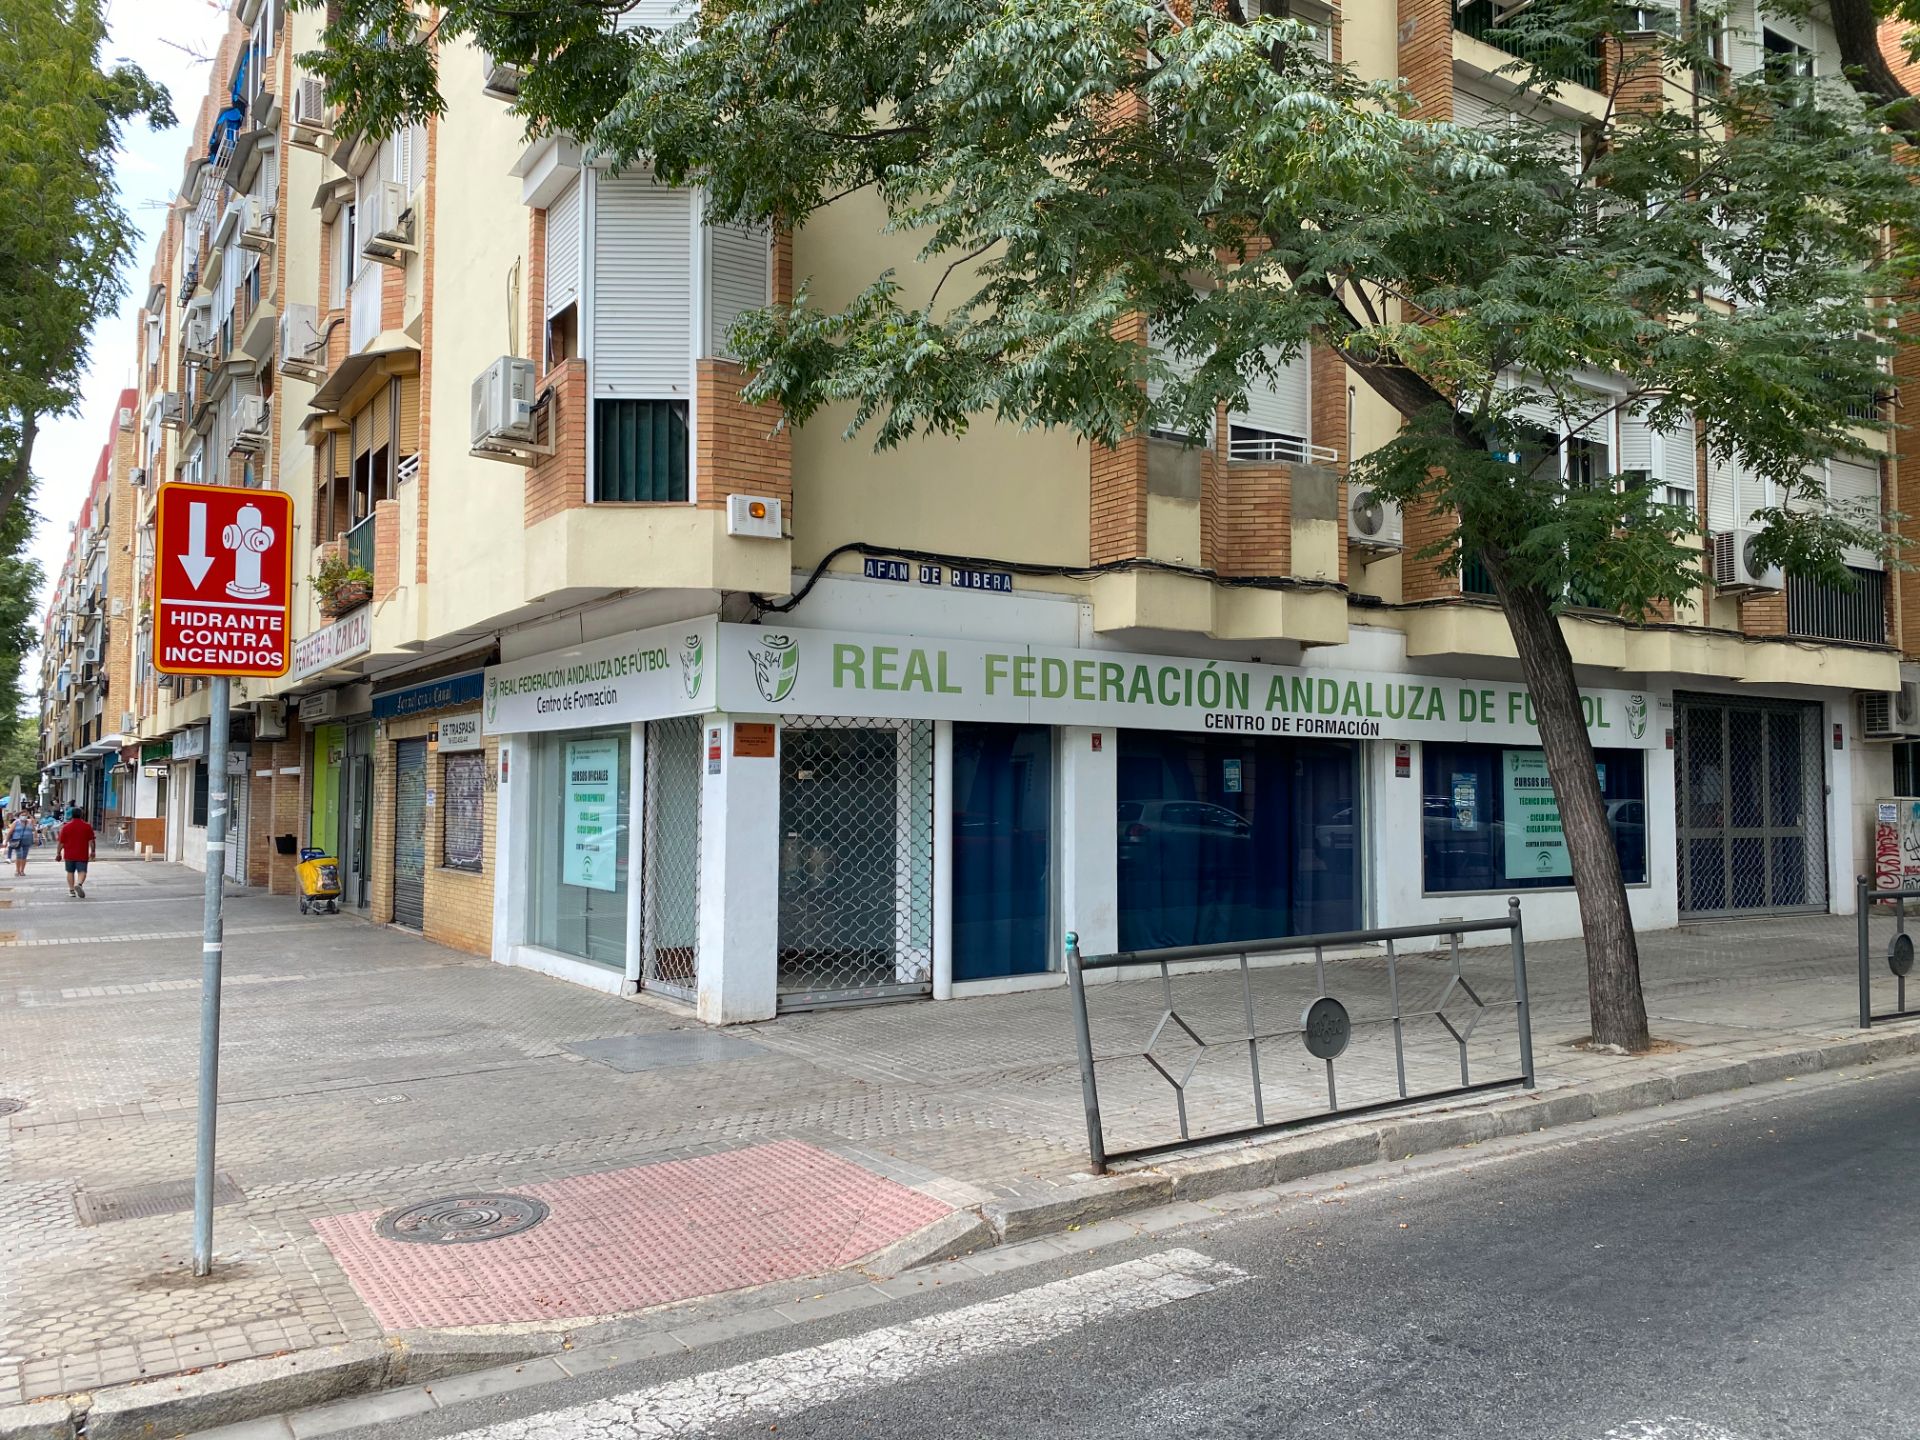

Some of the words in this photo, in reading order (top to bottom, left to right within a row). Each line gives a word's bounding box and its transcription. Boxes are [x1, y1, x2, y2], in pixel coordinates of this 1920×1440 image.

[865, 560, 909, 581] AFAN
[920, 565, 940, 584] DE
[951, 569, 1012, 591] RIBERA
[170, 610, 282, 632] HIDRANTE
[179, 629, 273, 648] CONTRA
[165, 646, 283, 667] INCENDIOS
[499, 678, 518, 697] REAL
[518, 665, 566, 693] FEDERACIÓN
[567, 657, 614, 686] ANDALUZA
[614, 655, 628, 676] DE
[629, 647, 671, 675] FÚTBOL
[831, 643, 963, 695] REAL
[984, 653, 1251, 711] FEDERACIÓN
[1264, 674, 1447, 722] ANDALUZA
[1458, 688, 1496, 724] DE
[536, 692, 562, 714] Centro
[562, 691, 573, 711] de
[573, 685, 618, 710] Formación
[442, 723, 449, 737] SE
[449, 720, 476, 736] TRASPASA
[1204, 712, 1266, 732] CENTRO
[1271, 715, 1292, 733] DE
[1296, 716, 1381, 737] FORMACIÓN
[1514, 776, 1540, 788] CURSOS
